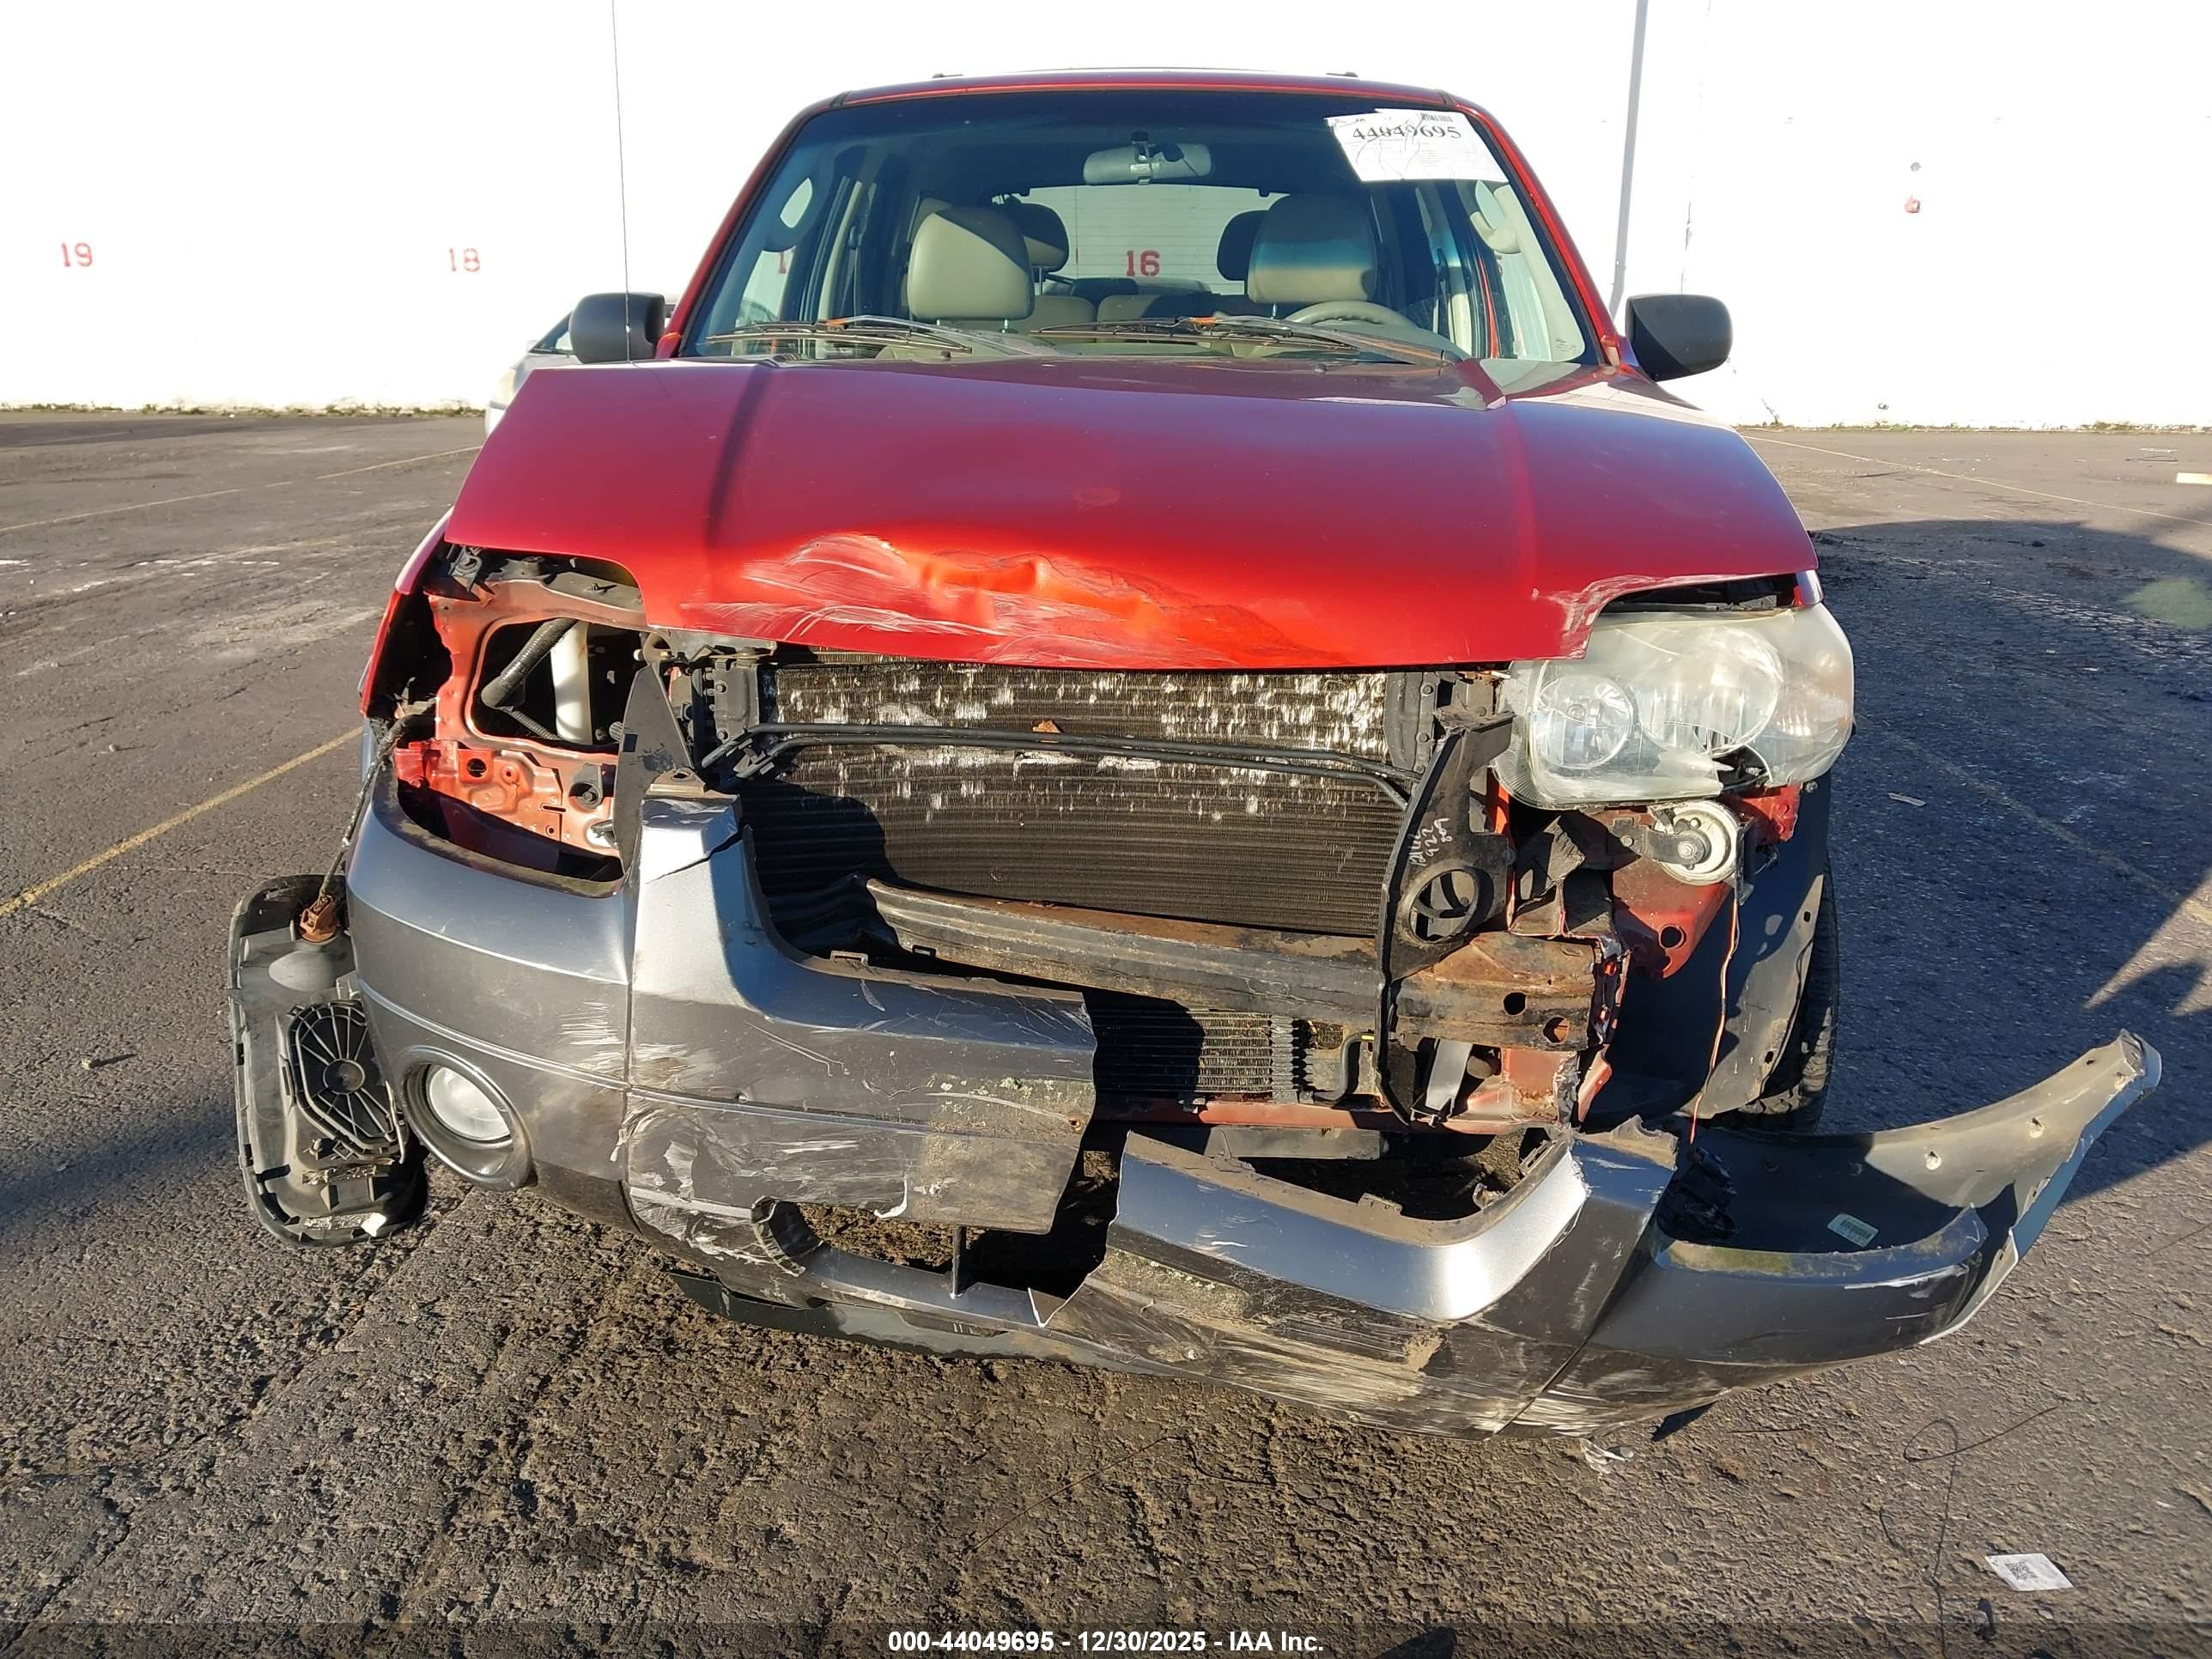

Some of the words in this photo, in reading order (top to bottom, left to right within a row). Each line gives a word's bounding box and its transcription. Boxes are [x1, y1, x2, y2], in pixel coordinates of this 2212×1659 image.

[61, 241, 93, 267] 19
[449, 247, 481, 272] 18
[1126, 250, 1160, 276] 16
